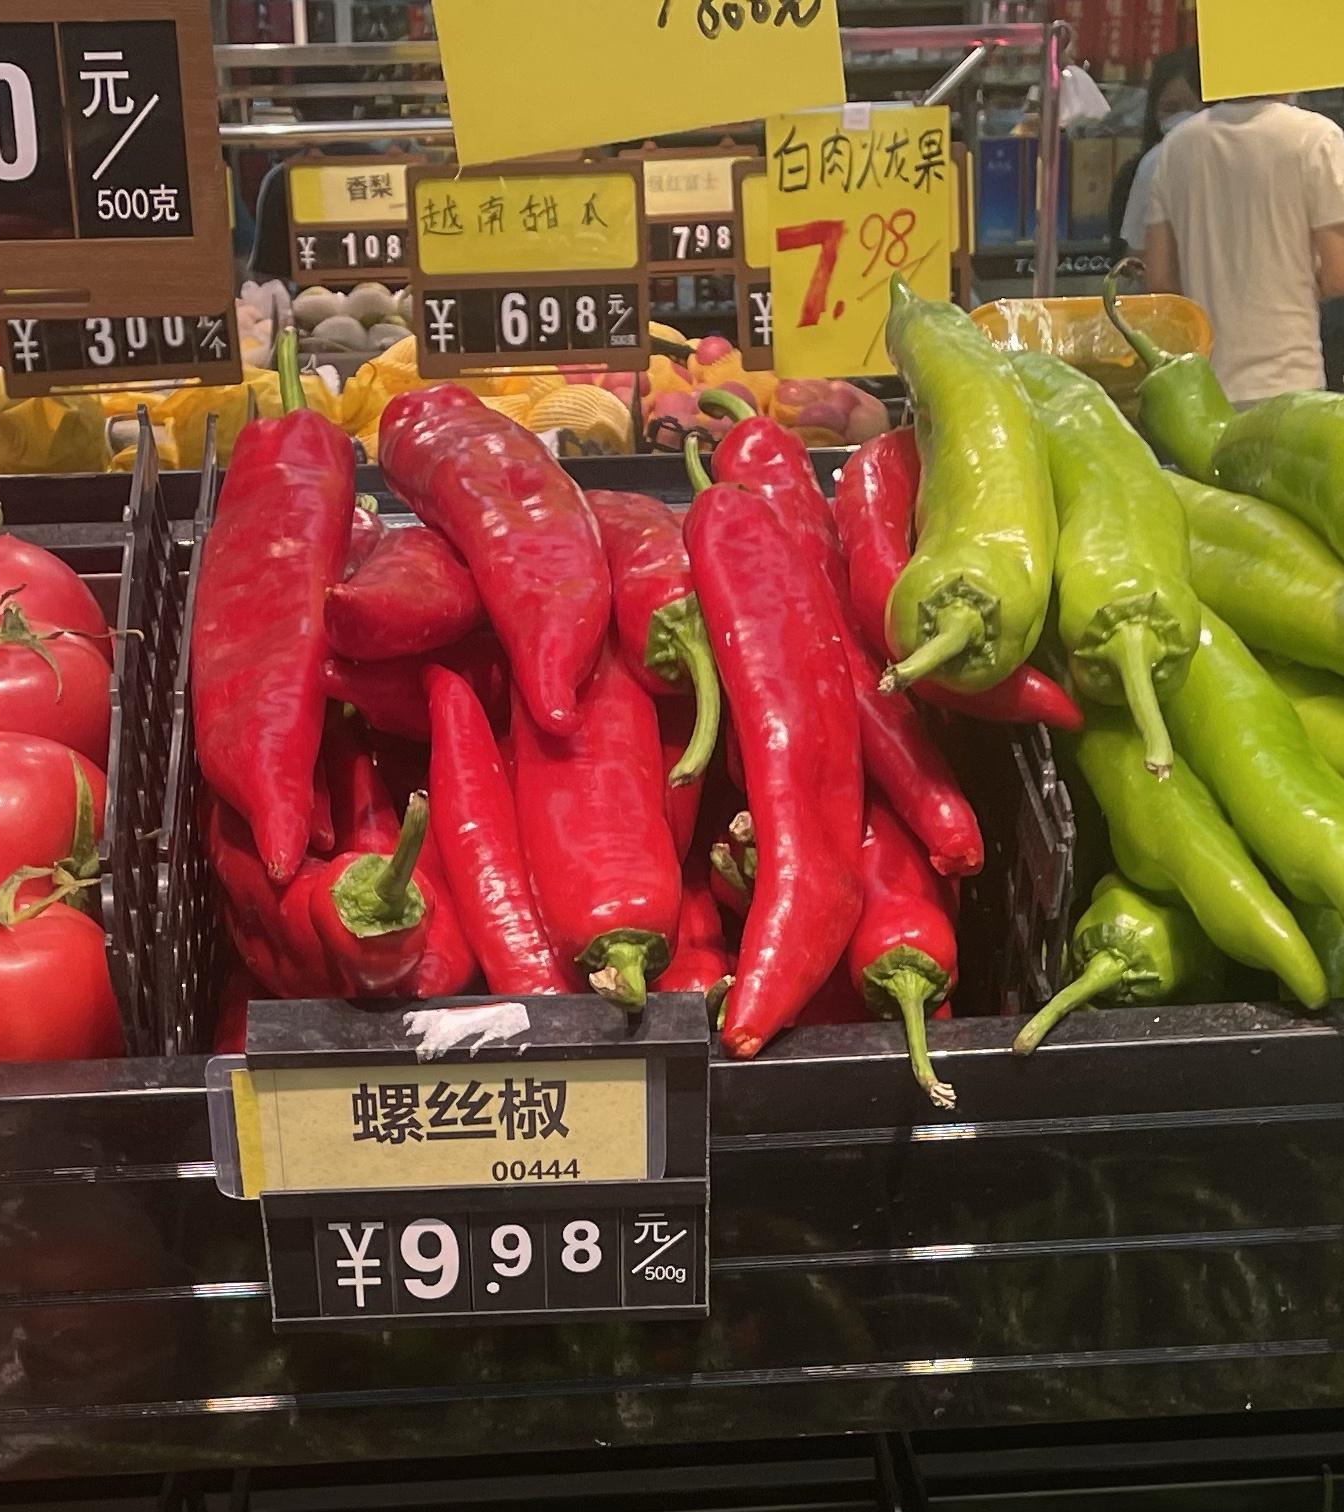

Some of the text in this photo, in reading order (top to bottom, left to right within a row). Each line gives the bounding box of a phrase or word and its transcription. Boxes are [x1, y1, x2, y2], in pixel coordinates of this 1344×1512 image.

[346, 172, 394, 202] 香梨
[352, 1077, 570, 1145] 螺丝椒
[491, 1157, 582, 1183] 00444
